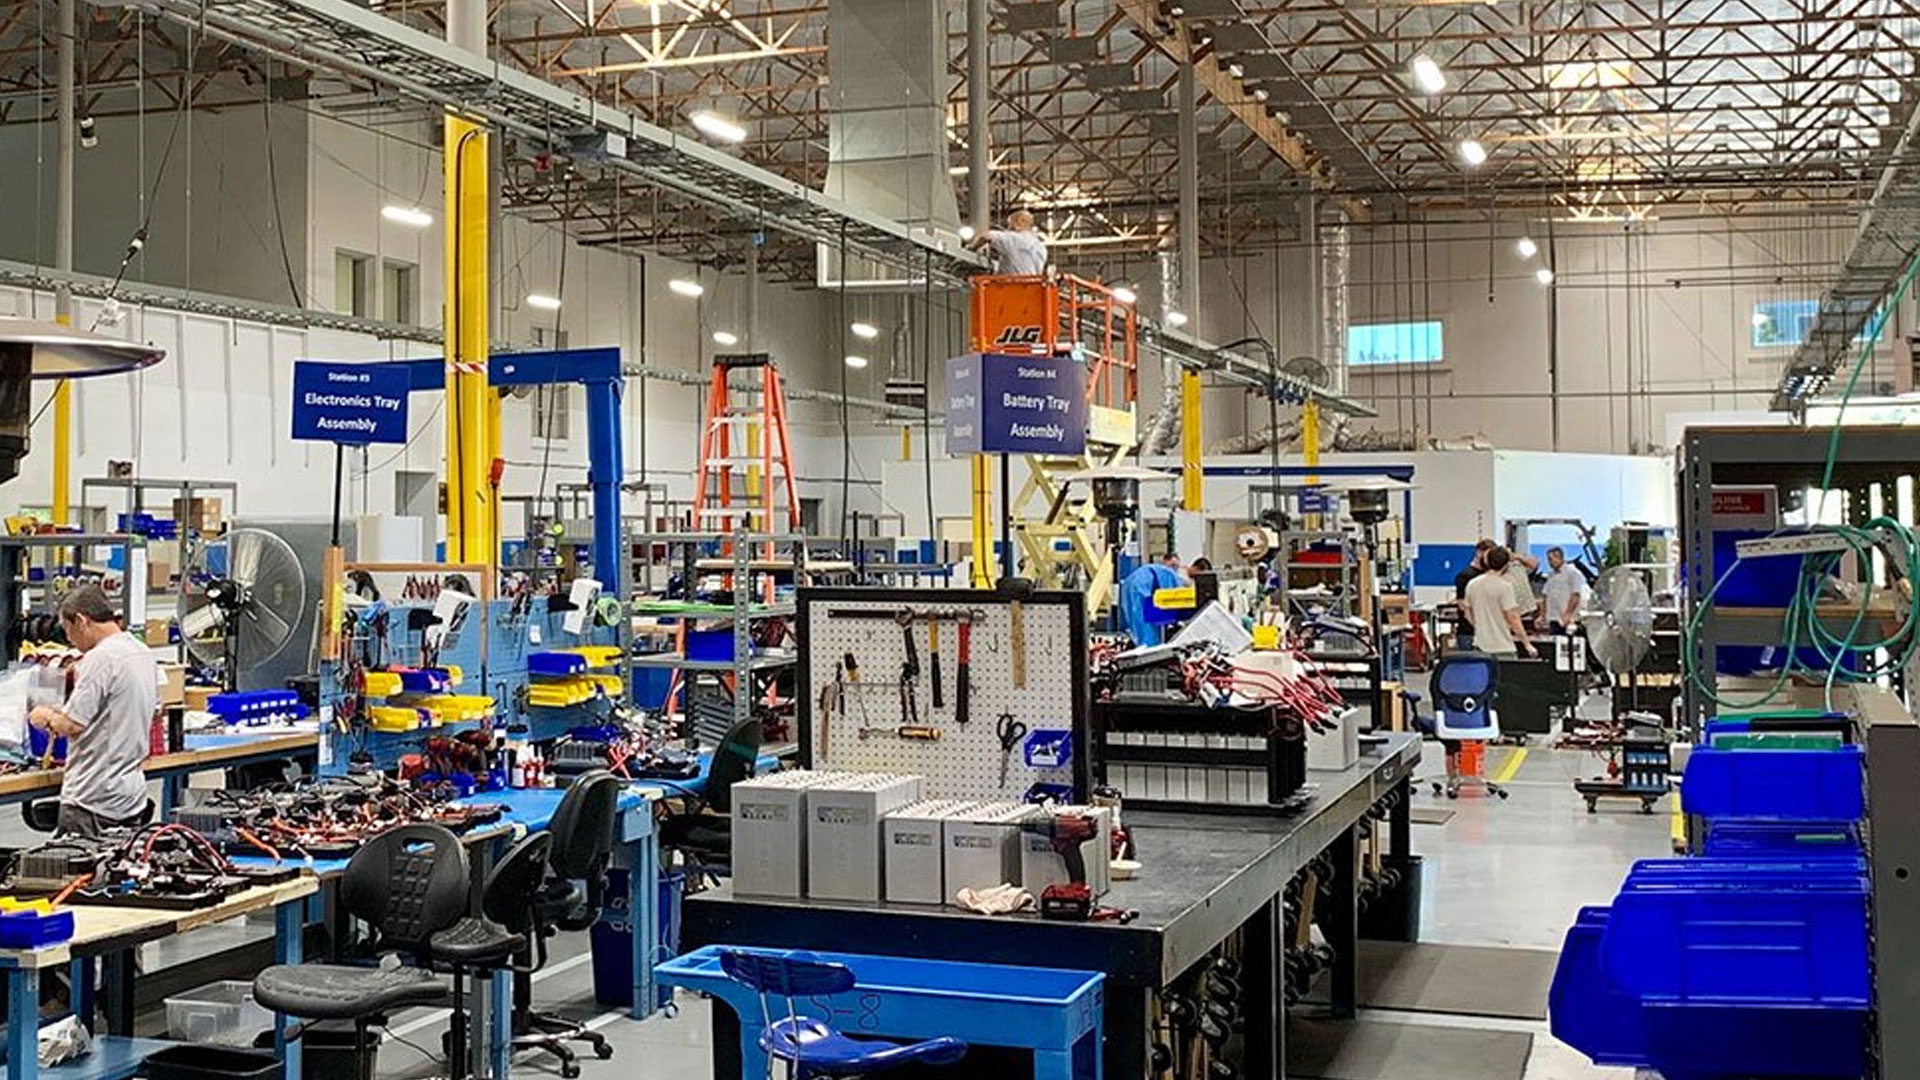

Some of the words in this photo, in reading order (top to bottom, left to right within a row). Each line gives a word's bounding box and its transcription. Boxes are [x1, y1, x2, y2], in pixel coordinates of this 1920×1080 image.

[995, 326, 1042, 344] JLG
[328, 371, 358, 382] Station
[1017, 366, 1045, 379] Station
[305, 392, 371, 407] Electronics
[373, 395, 401, 411] Tray
[1003, 392, 1044, 412] Battery
[1046, 395, 1070, 413] Tray
[317, 417, 377, 434] Assembly
[1010, 422, 1064, 442] Assembly
